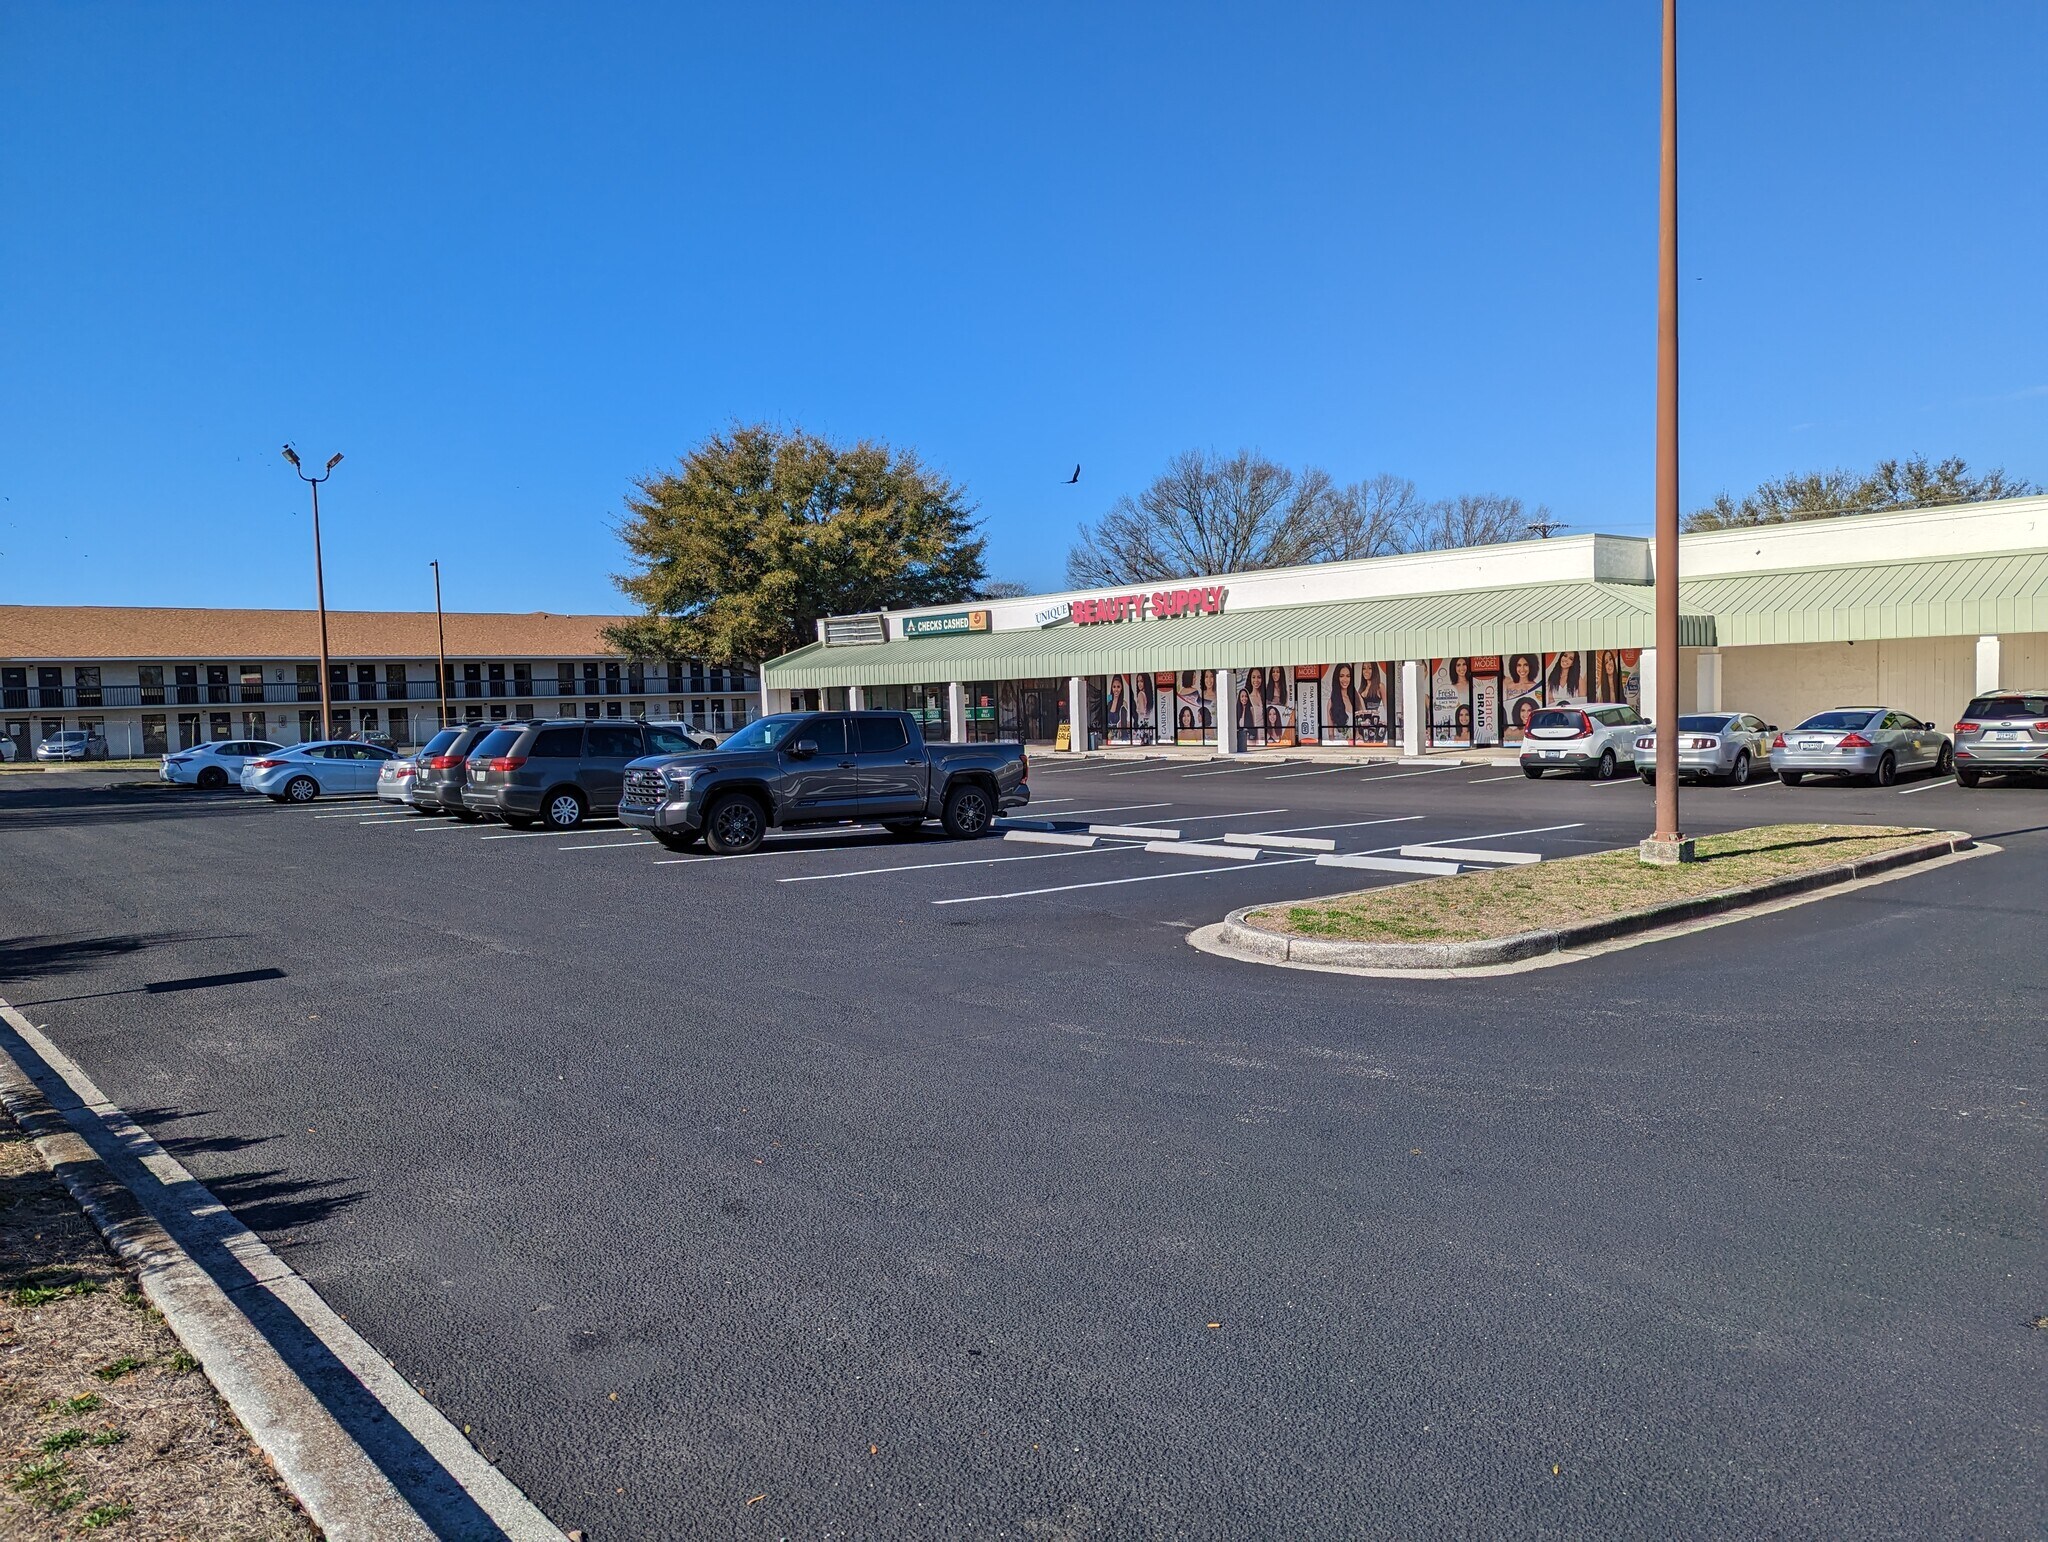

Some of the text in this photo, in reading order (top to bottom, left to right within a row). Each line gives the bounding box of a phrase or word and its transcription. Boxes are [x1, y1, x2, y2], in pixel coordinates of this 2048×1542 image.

[1072, 586, 1225, 624] BEAUTY SUPPLY
[1035, 602, 1068, 624] UNIQUE
[917, 617, 969, 632] CHECKS CASHED
[1298, 667, 1316, 675] MODEL
[1474, 660, 1497, 668] MODEL
[1438, 689, 1456, 697] Fresh
[1477, 693, 1485, 728] BRAID
[1485, 685, 1495, 731] Glance
[1057, 732, 1071, 740] SALE
